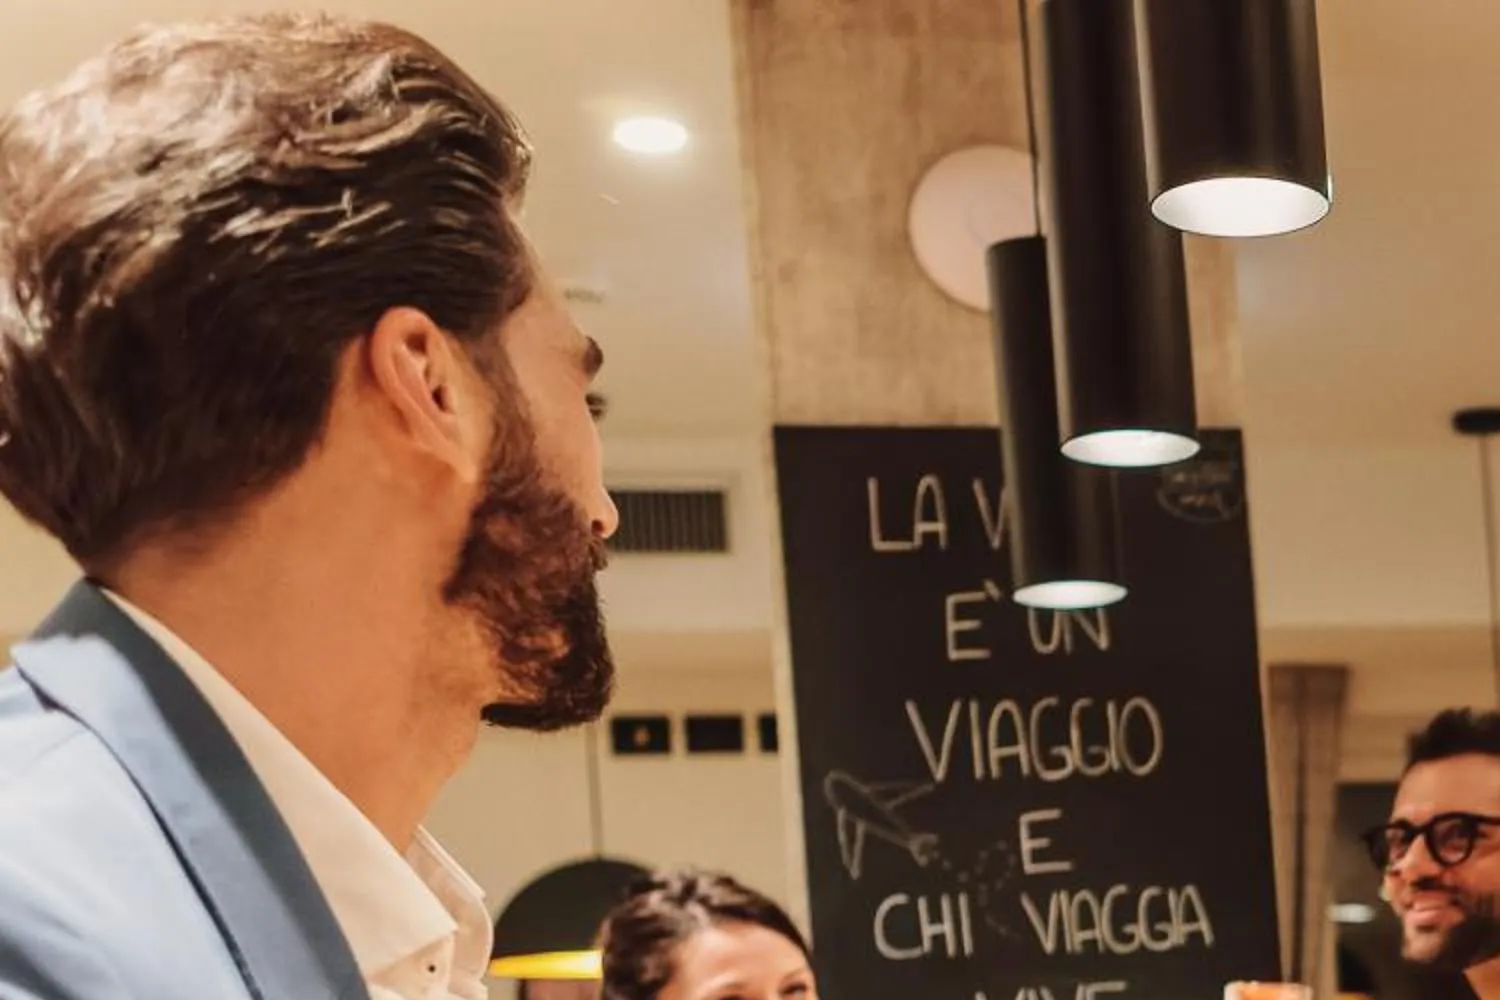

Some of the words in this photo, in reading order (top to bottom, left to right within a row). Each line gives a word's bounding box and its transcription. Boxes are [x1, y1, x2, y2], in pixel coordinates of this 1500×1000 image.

[867, 474, 947, 551] LA
[905, 697, 1164, 783] VIAGGIO
[1018, 809, 1073, 875] E
[873, 894, 974, 960] CHI
[1021, 884, 1215, 955] VIAGGIA
